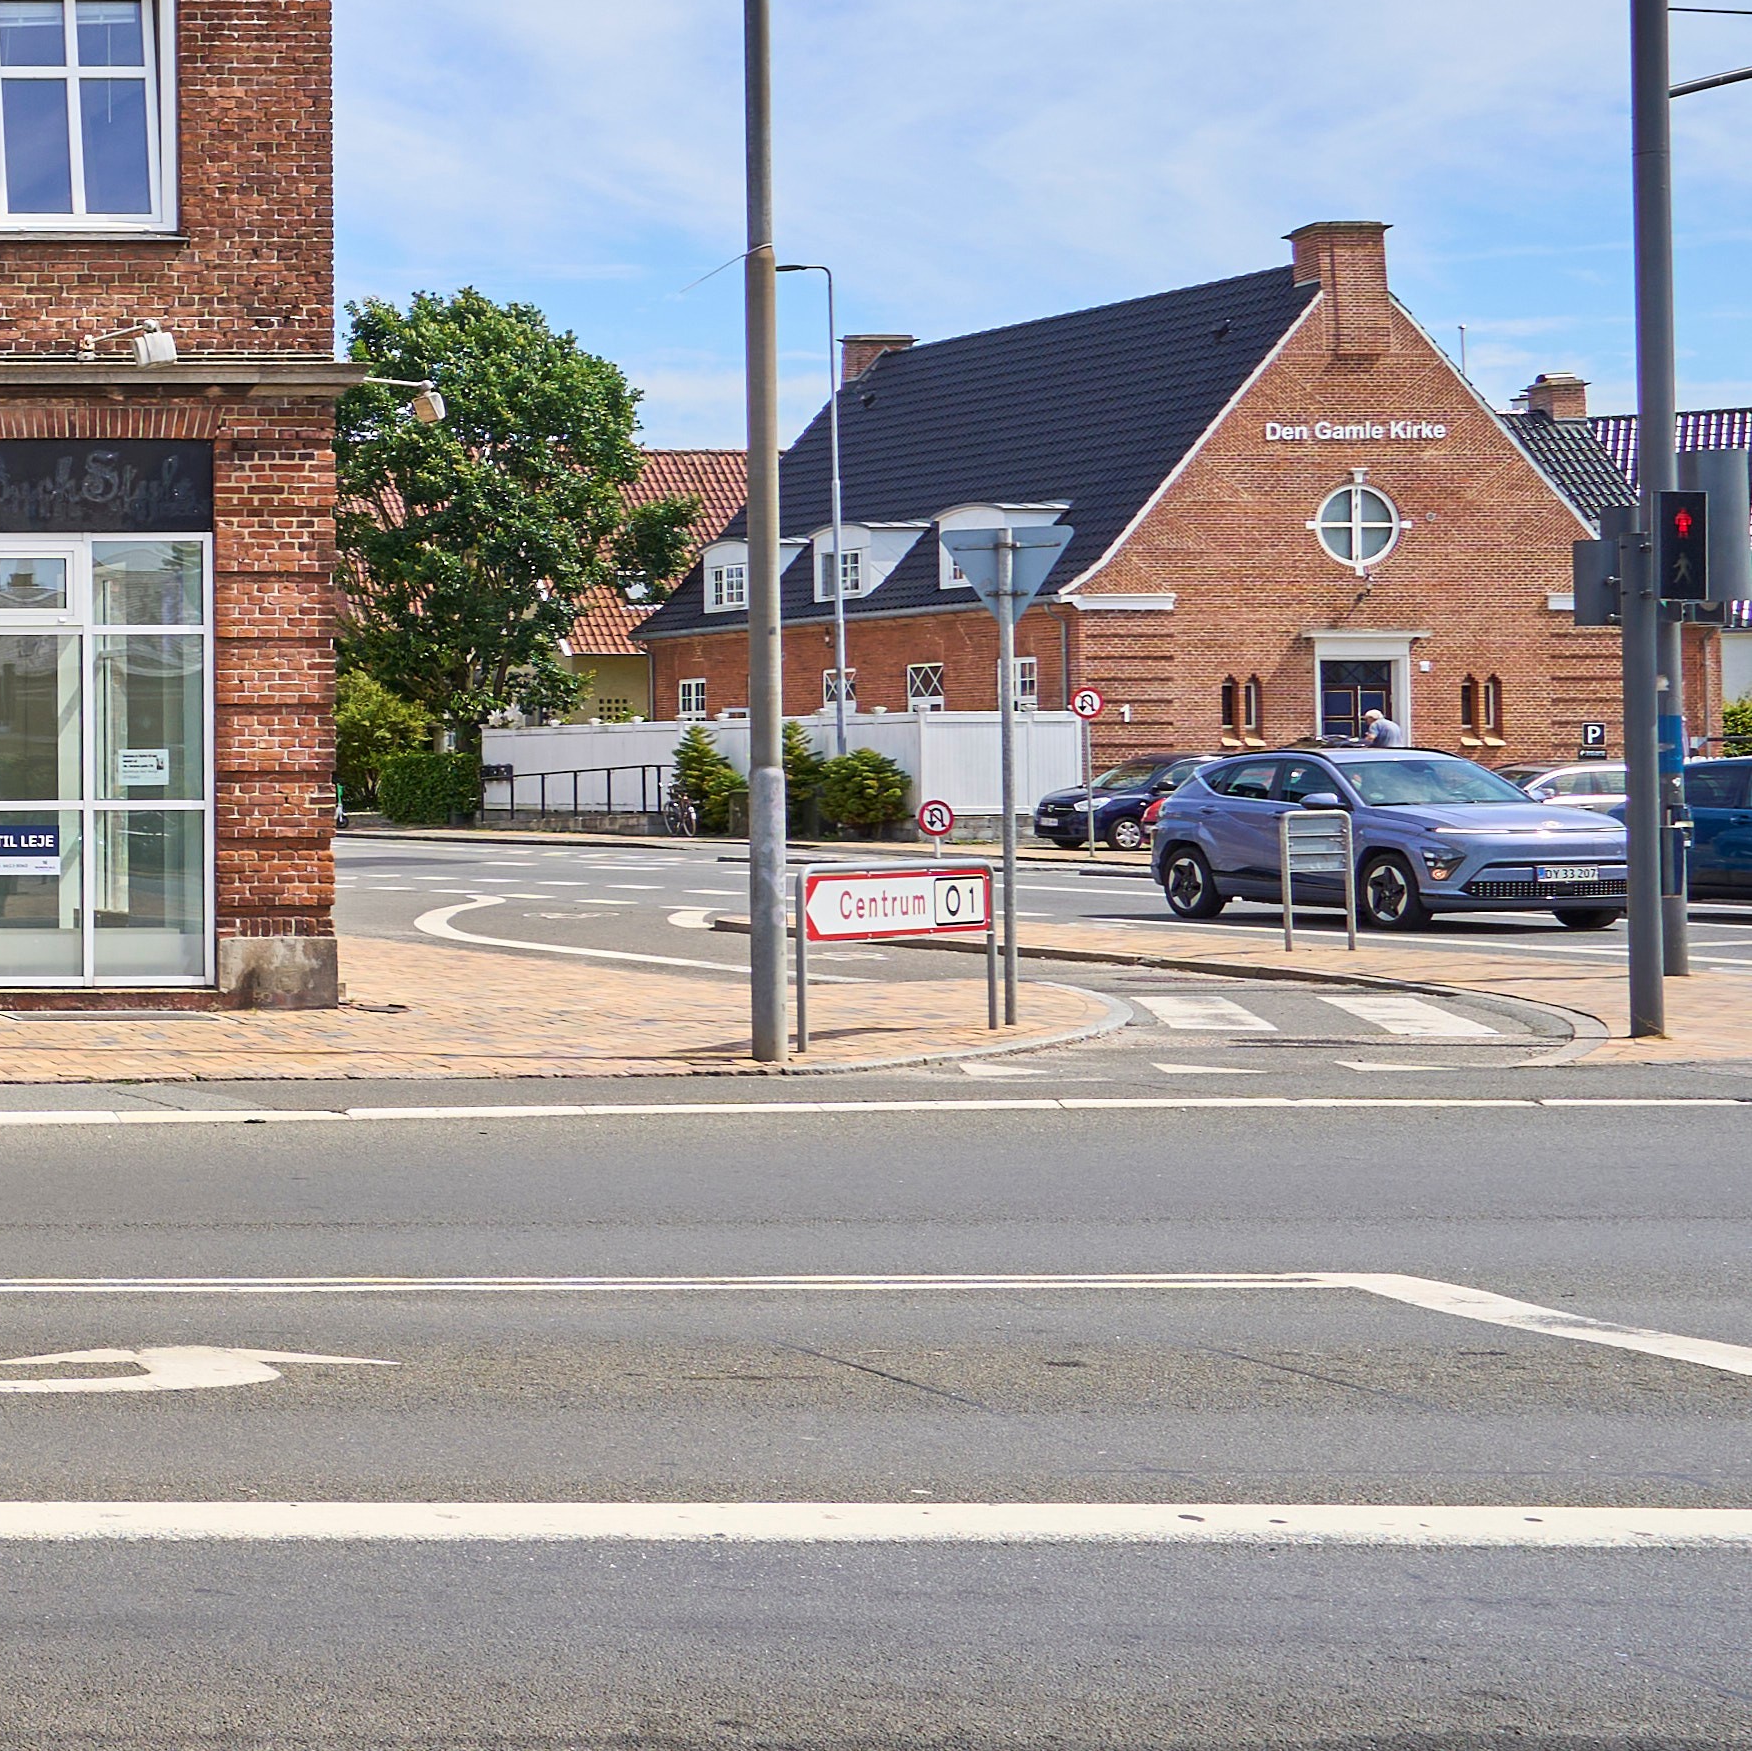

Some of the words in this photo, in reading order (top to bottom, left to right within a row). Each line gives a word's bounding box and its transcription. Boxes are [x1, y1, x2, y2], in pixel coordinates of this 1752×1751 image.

[1265, 422, 1308, 442] Den
[1314, 421, 1384, 442] Gamle
[1389, 419, 1447, 441] Kirke
[1119, 703, 1132, 723] 1
[1587, 725, 1602, 744] P
[20, 834, 55, 848] LEJE
[1562, 869, 1575, 879] 33
[1577, 868, 1596, 878] 207
[840, 888, 927, 921] Centrum
